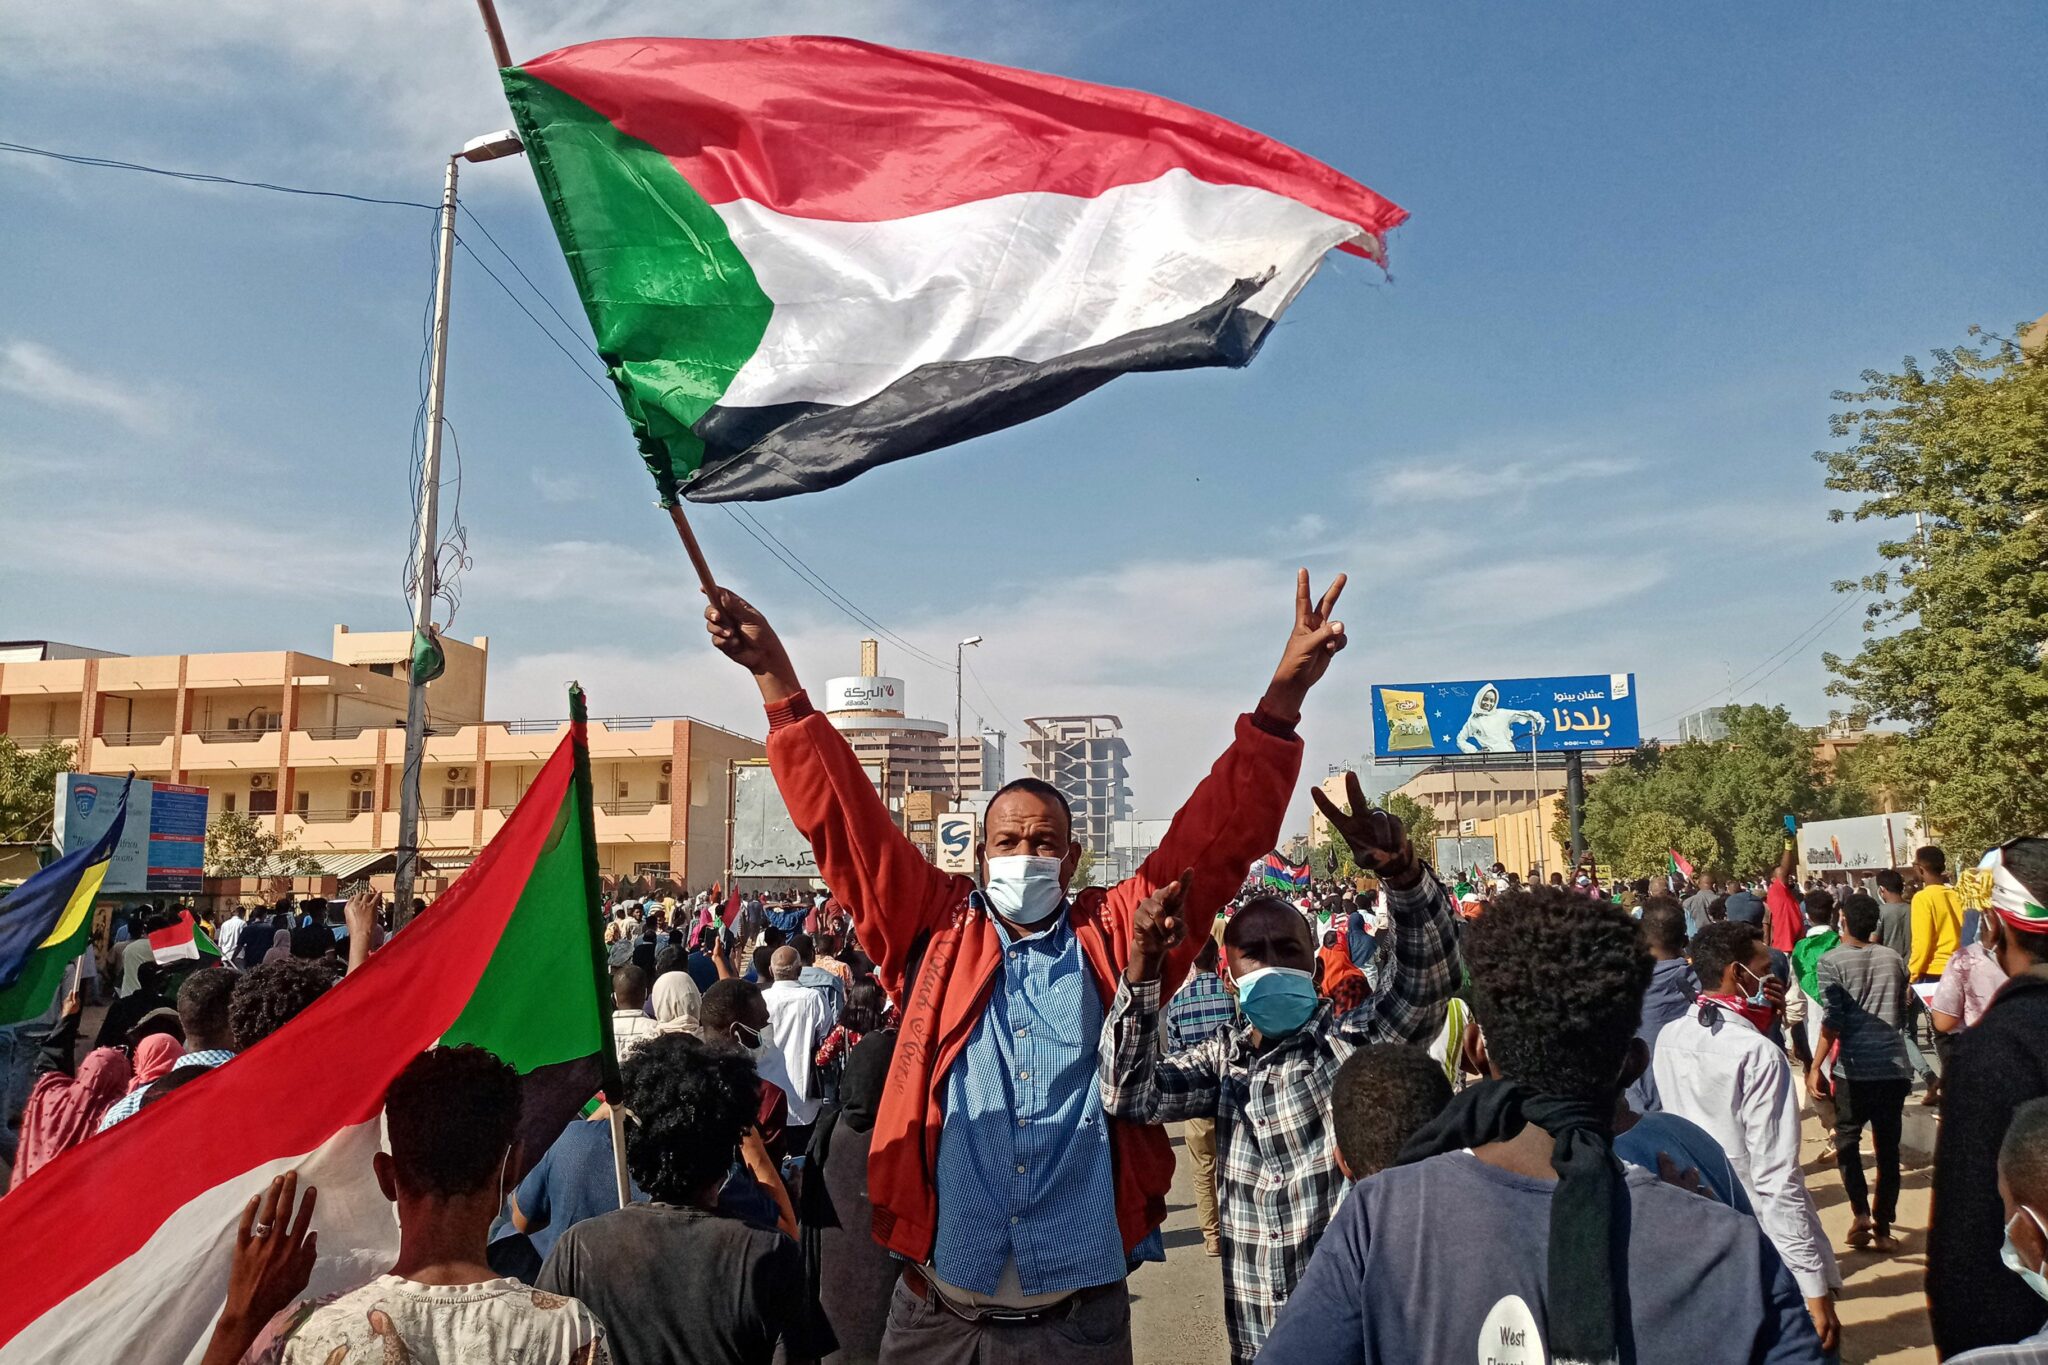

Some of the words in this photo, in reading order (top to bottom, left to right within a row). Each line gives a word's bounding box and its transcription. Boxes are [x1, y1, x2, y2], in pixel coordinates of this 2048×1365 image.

[844, 686, 883, 701] البركة
[1576, 688, 1605, 701] عشان
[1552, 705, 1612, 738] بلدنا
[775, 850, 817, 871] حكومة
[1499, 1325, 1526, 1348] West
